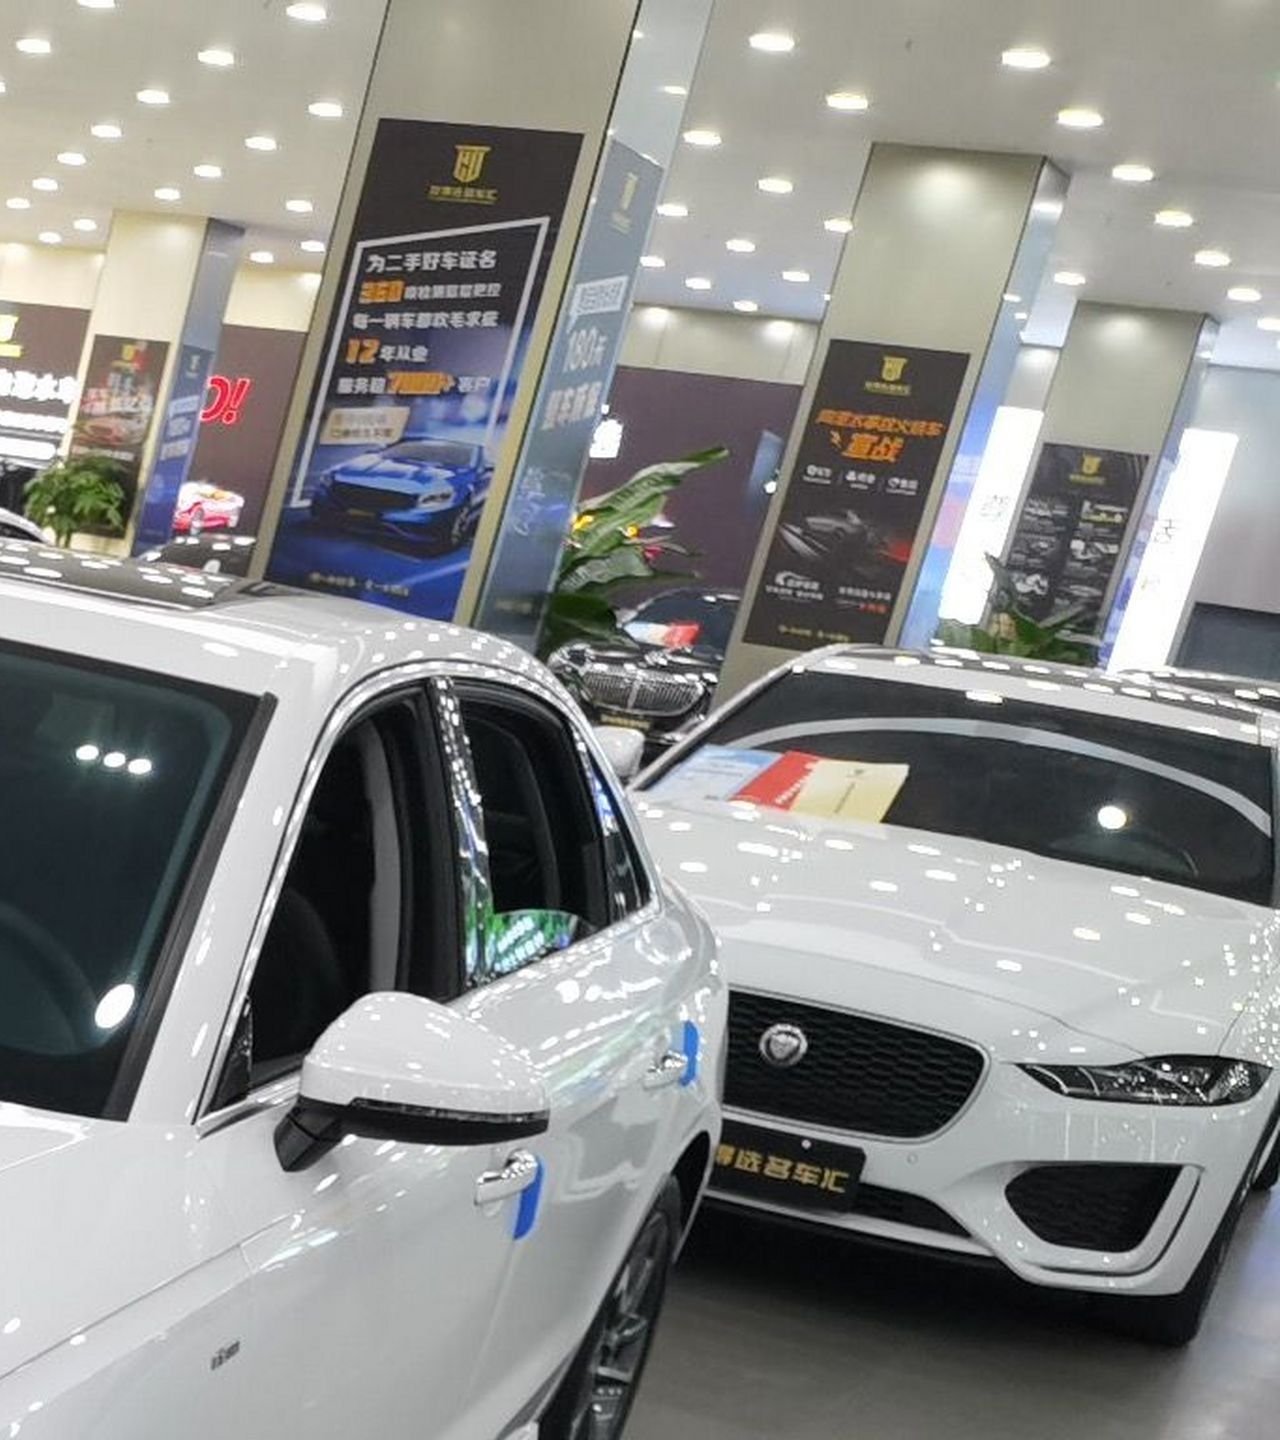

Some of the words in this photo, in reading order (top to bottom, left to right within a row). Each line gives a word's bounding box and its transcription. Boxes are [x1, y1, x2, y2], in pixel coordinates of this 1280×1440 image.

[366, 250, 498, 273] 为二手好车证名
